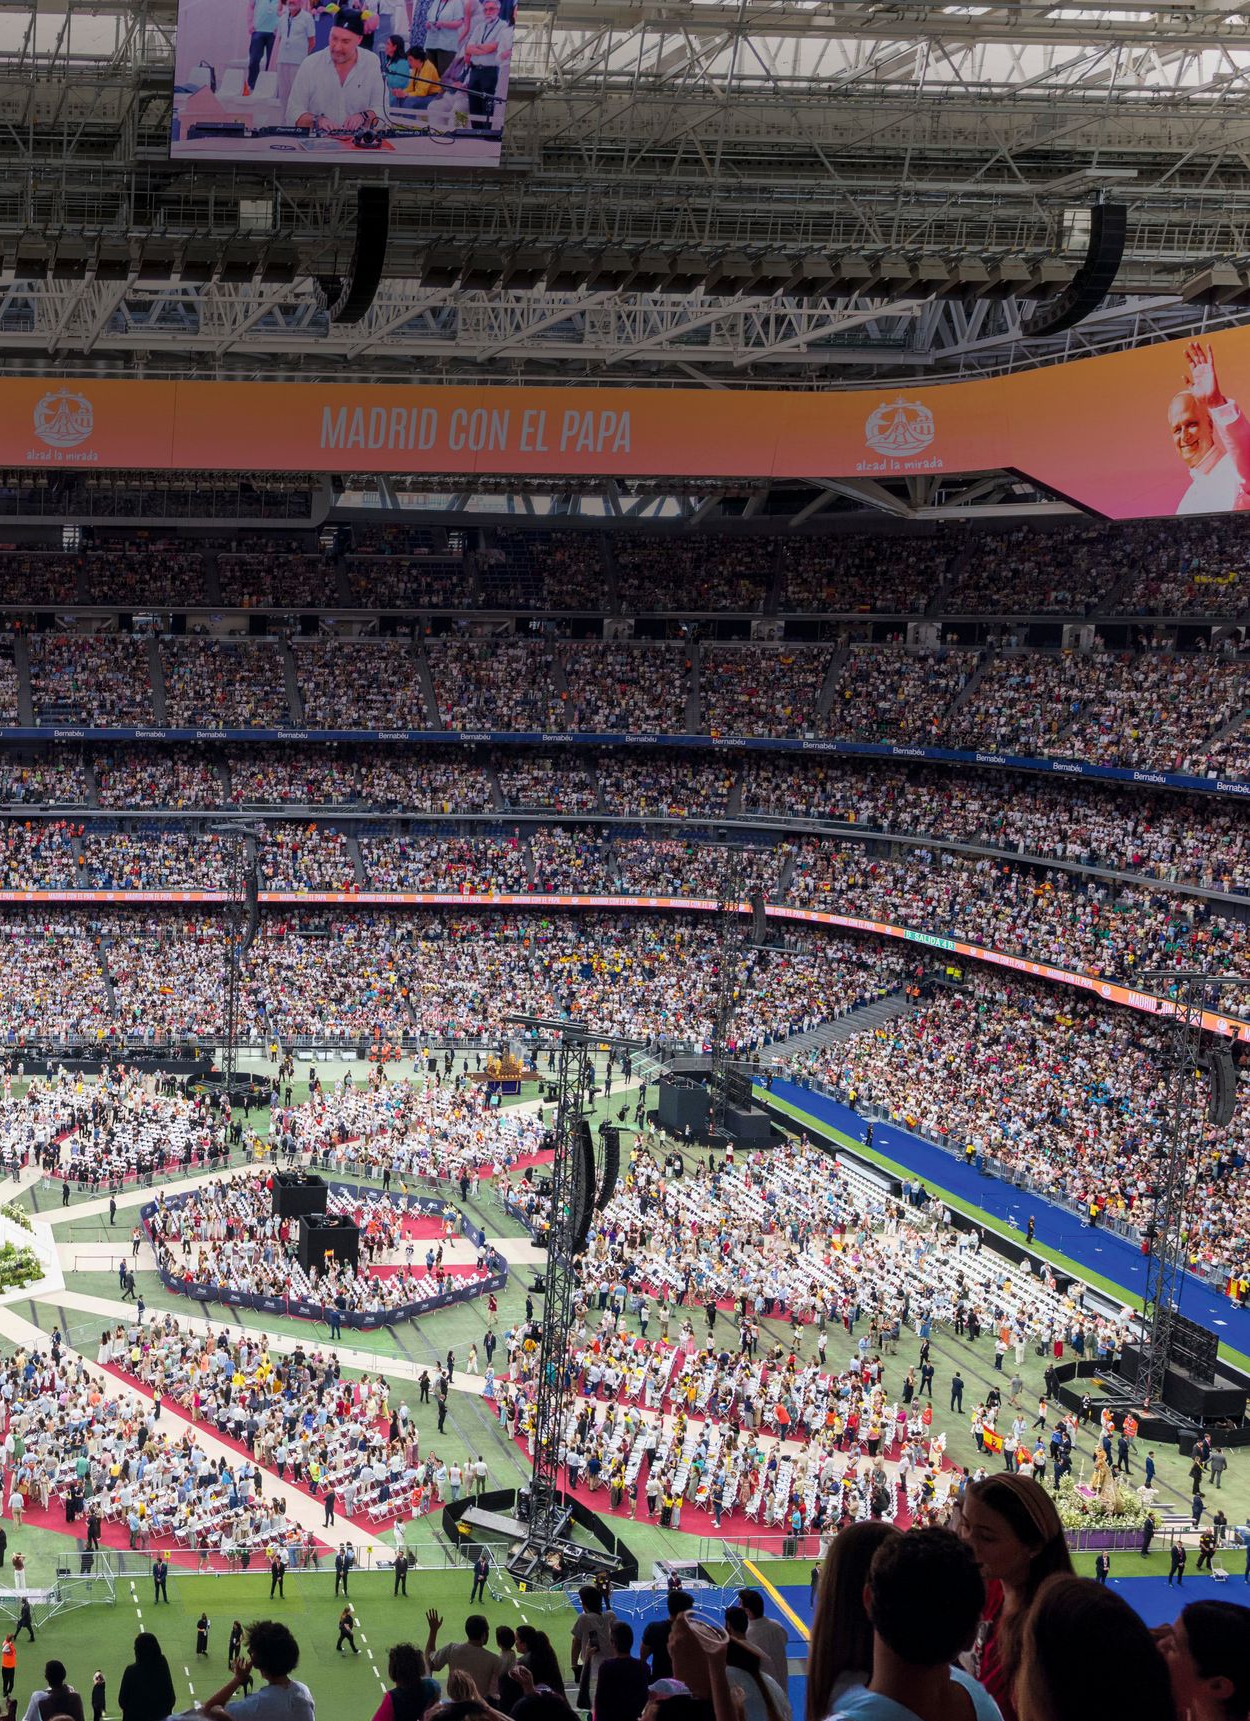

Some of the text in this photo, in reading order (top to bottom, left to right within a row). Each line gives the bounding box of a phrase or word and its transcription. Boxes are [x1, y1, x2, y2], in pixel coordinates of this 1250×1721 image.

[320, 407, 632, 454] MADRID CON EL PAPA
[26, 448, 98, 461] alzad la mirada
[856, 456, 942, 471] alzad la mirada
[893, 746, 924, 755] Bernabéu
[976, 754, 1006, 763] Bernabéu
[1053, 762, 1082, 772] Bernabéu
[1134, 772, 1166, 782] Bernabéu
[915, 933, 941, 946] SALIDA
[1129, 994, 1156, 1011] MADRID
